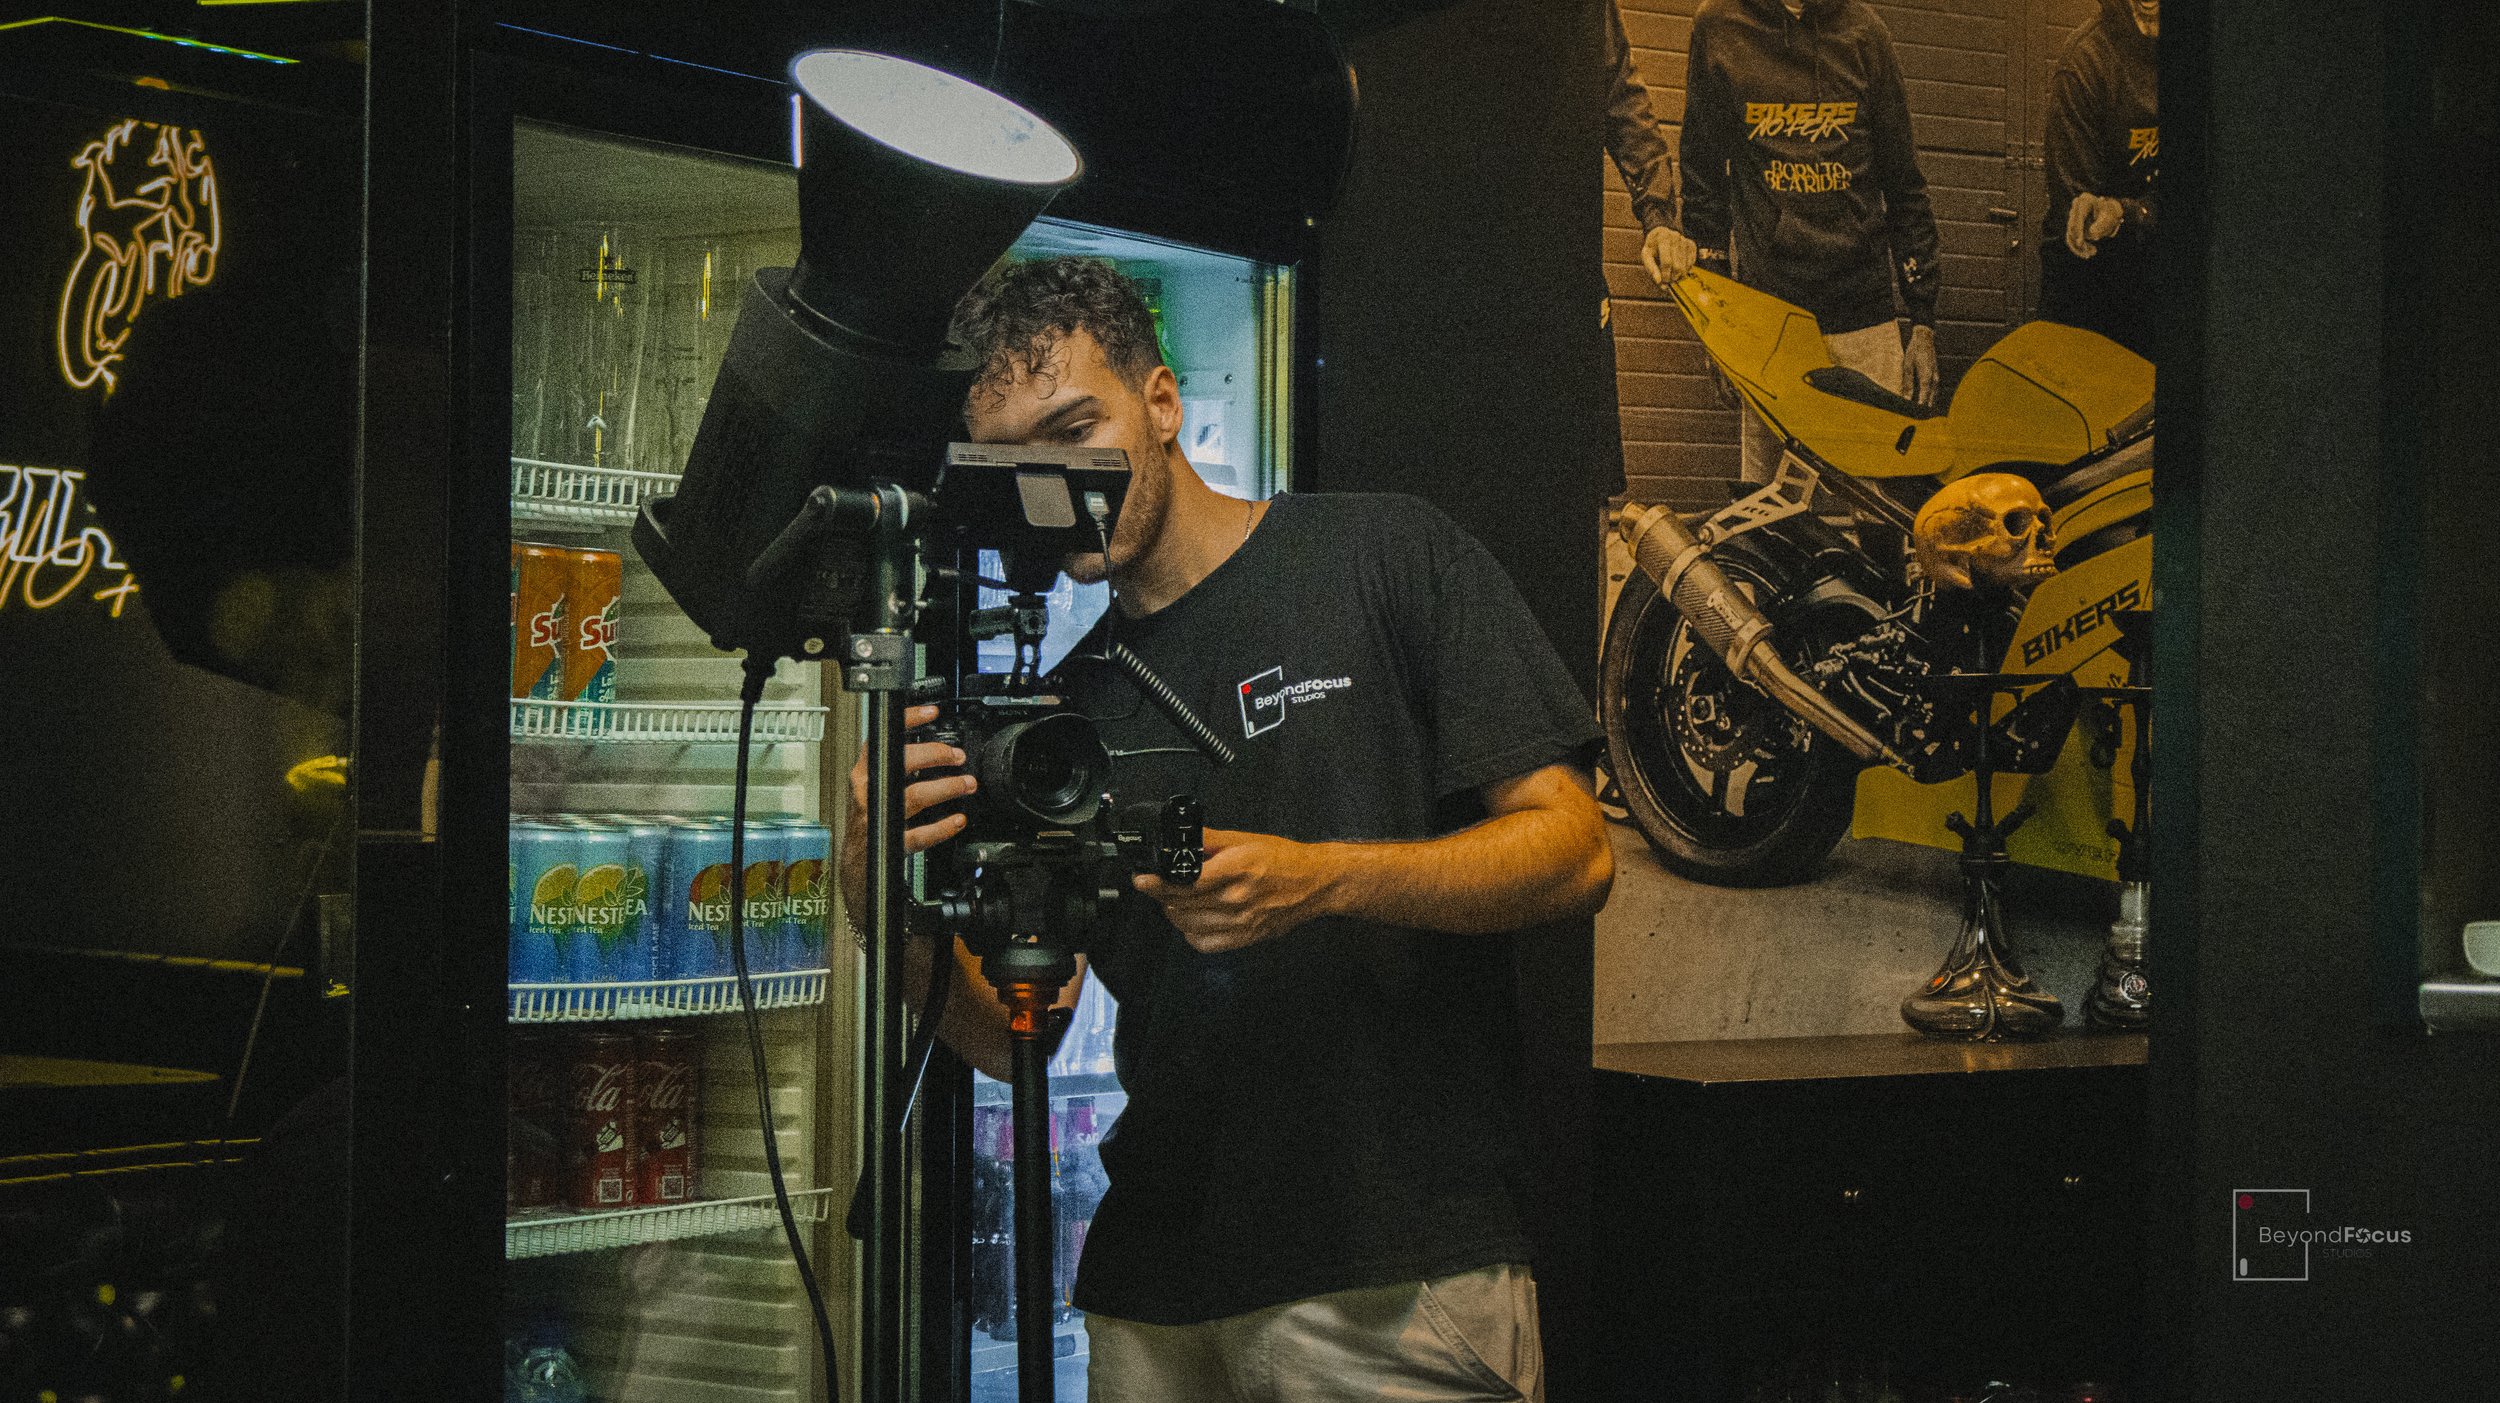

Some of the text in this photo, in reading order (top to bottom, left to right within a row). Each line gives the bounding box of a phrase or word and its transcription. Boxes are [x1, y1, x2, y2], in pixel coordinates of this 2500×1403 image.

[1745, 102, 1857, 125] BIKERS
[1747, 117, 1785, 141] NO
[1771, 160, 1820, 182] BORN
[2022, 579, 2140, 668] BIKERS
[1291, 691, 1326, 704] STUDIOS
[530, 904, 573, 925] NEST
[688, 901, 732, 922] NEST
